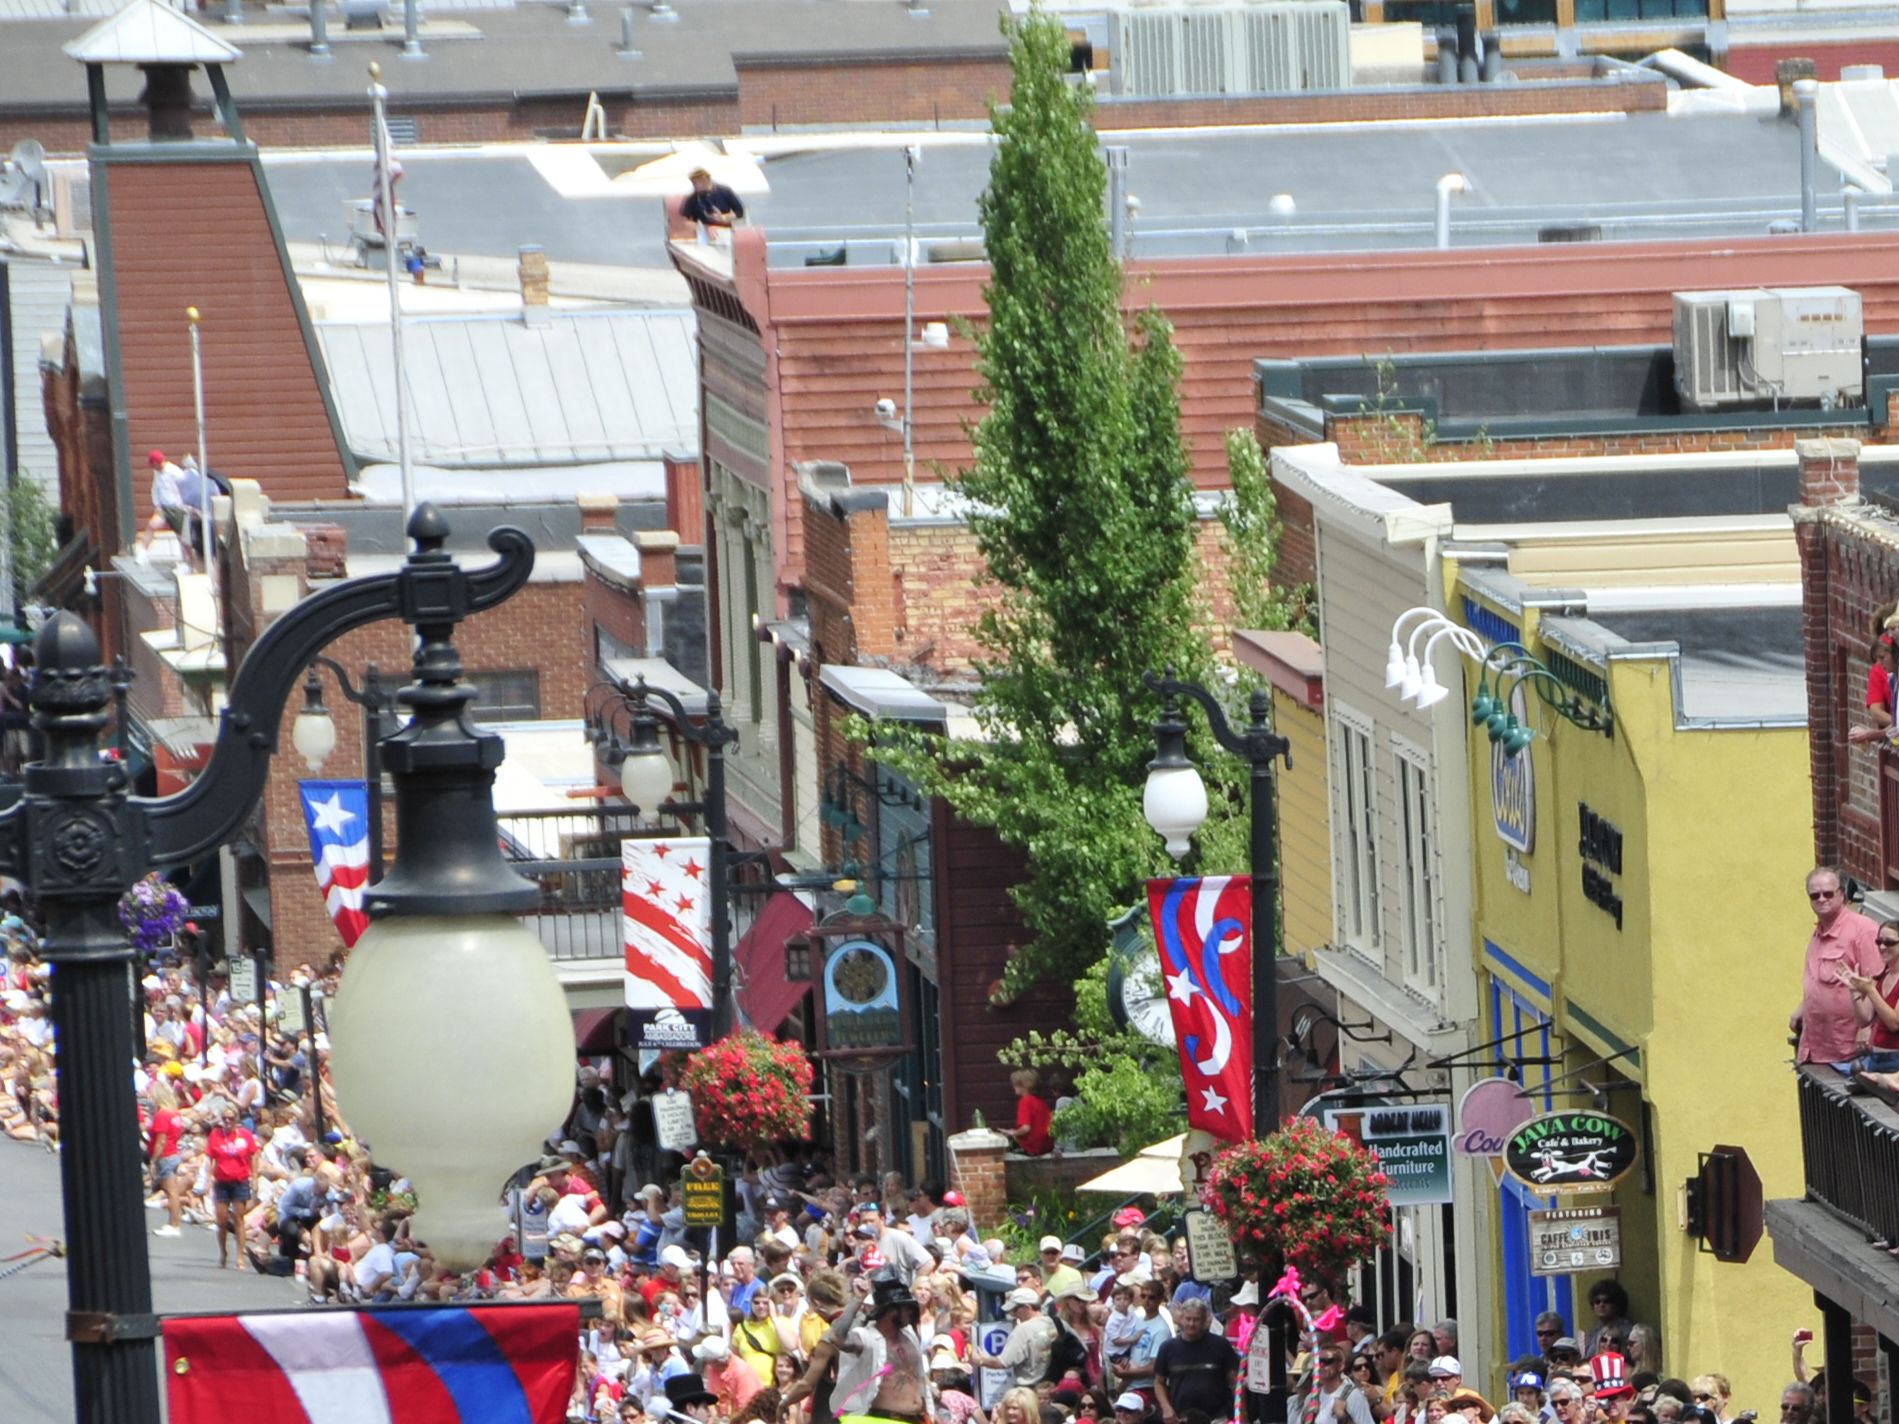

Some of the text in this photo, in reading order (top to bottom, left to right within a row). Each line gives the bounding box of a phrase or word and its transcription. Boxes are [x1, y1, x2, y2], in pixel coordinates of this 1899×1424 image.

[643, 1023, 696, 1031] PARK CITY
[1514, 1116, 1625, 1155] JAVA COW
[1560, 1138, 1569, 1147] &
[1571, 1136, 1603, 1147] Bakery
[1368, 1140, 1443, 1159] Handcrafted
[1378, 1160, 1435, 1175] Furniture
[1545, 1208, 1603, 1219] FEATURING
[1587, 1229, 1611, 1242] IBIS
